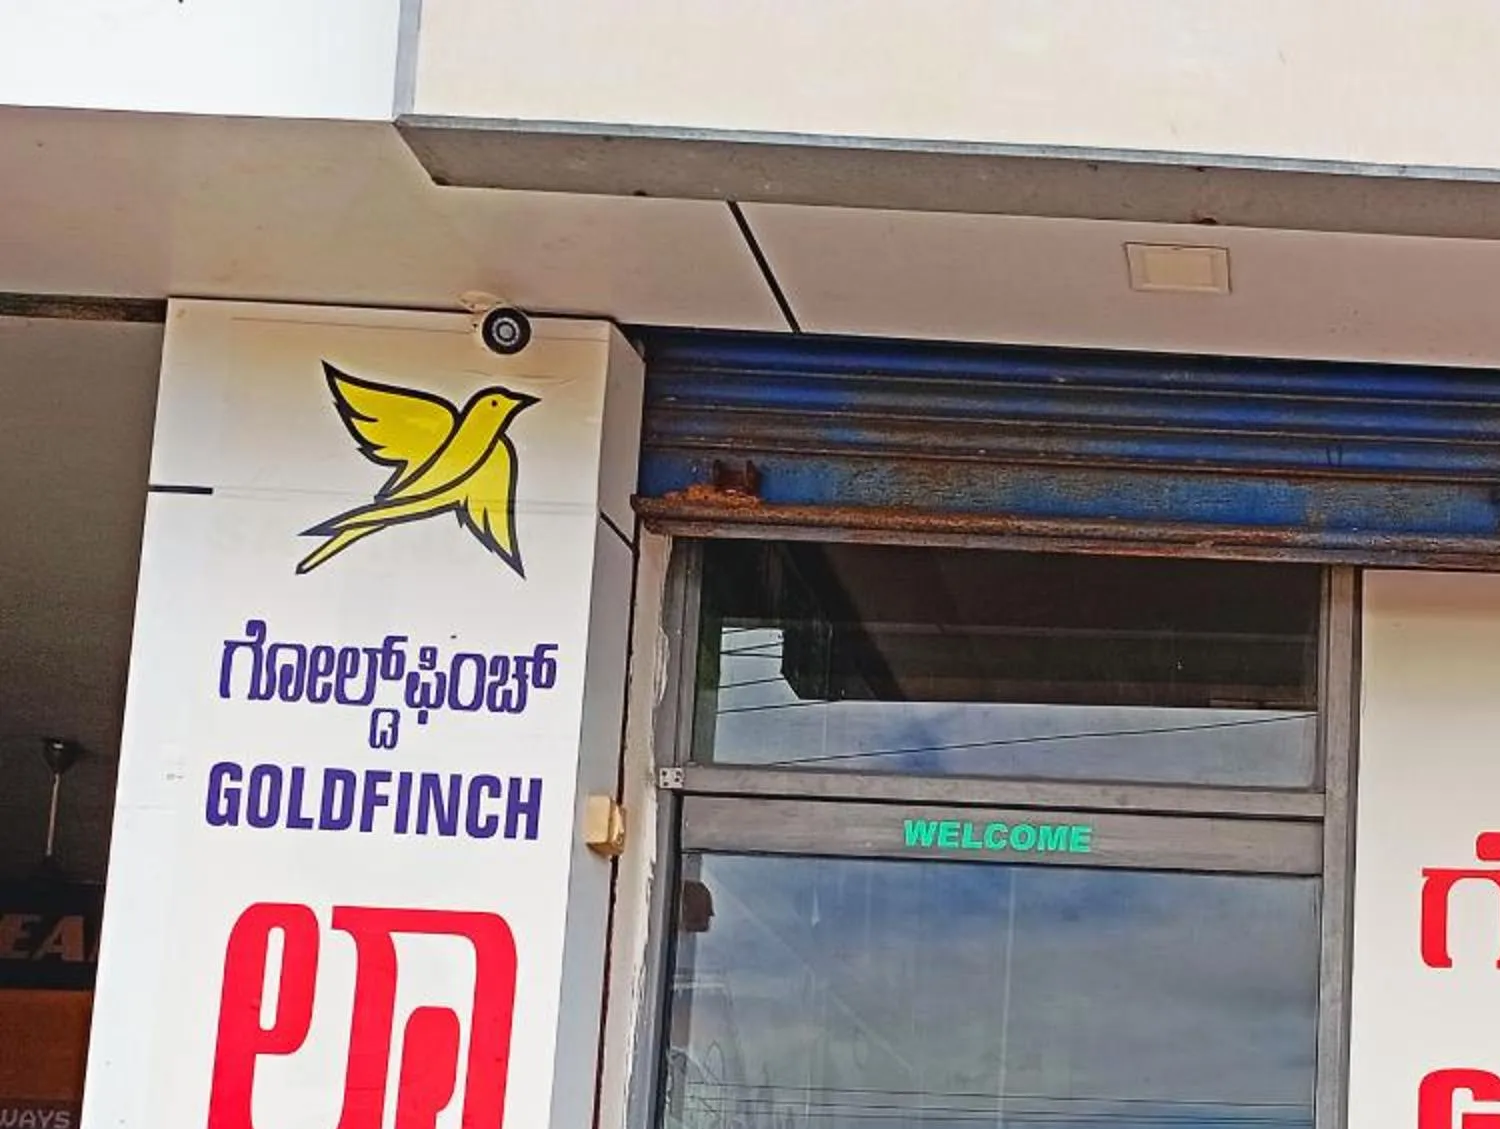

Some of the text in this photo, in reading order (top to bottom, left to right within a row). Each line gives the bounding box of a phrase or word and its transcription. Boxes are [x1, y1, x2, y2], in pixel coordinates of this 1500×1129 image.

[206, 762, 543, 840] GOLDFINCH
[903, 818, 1093, 854] WELCOME
[0, 914, 98, 961] EA
